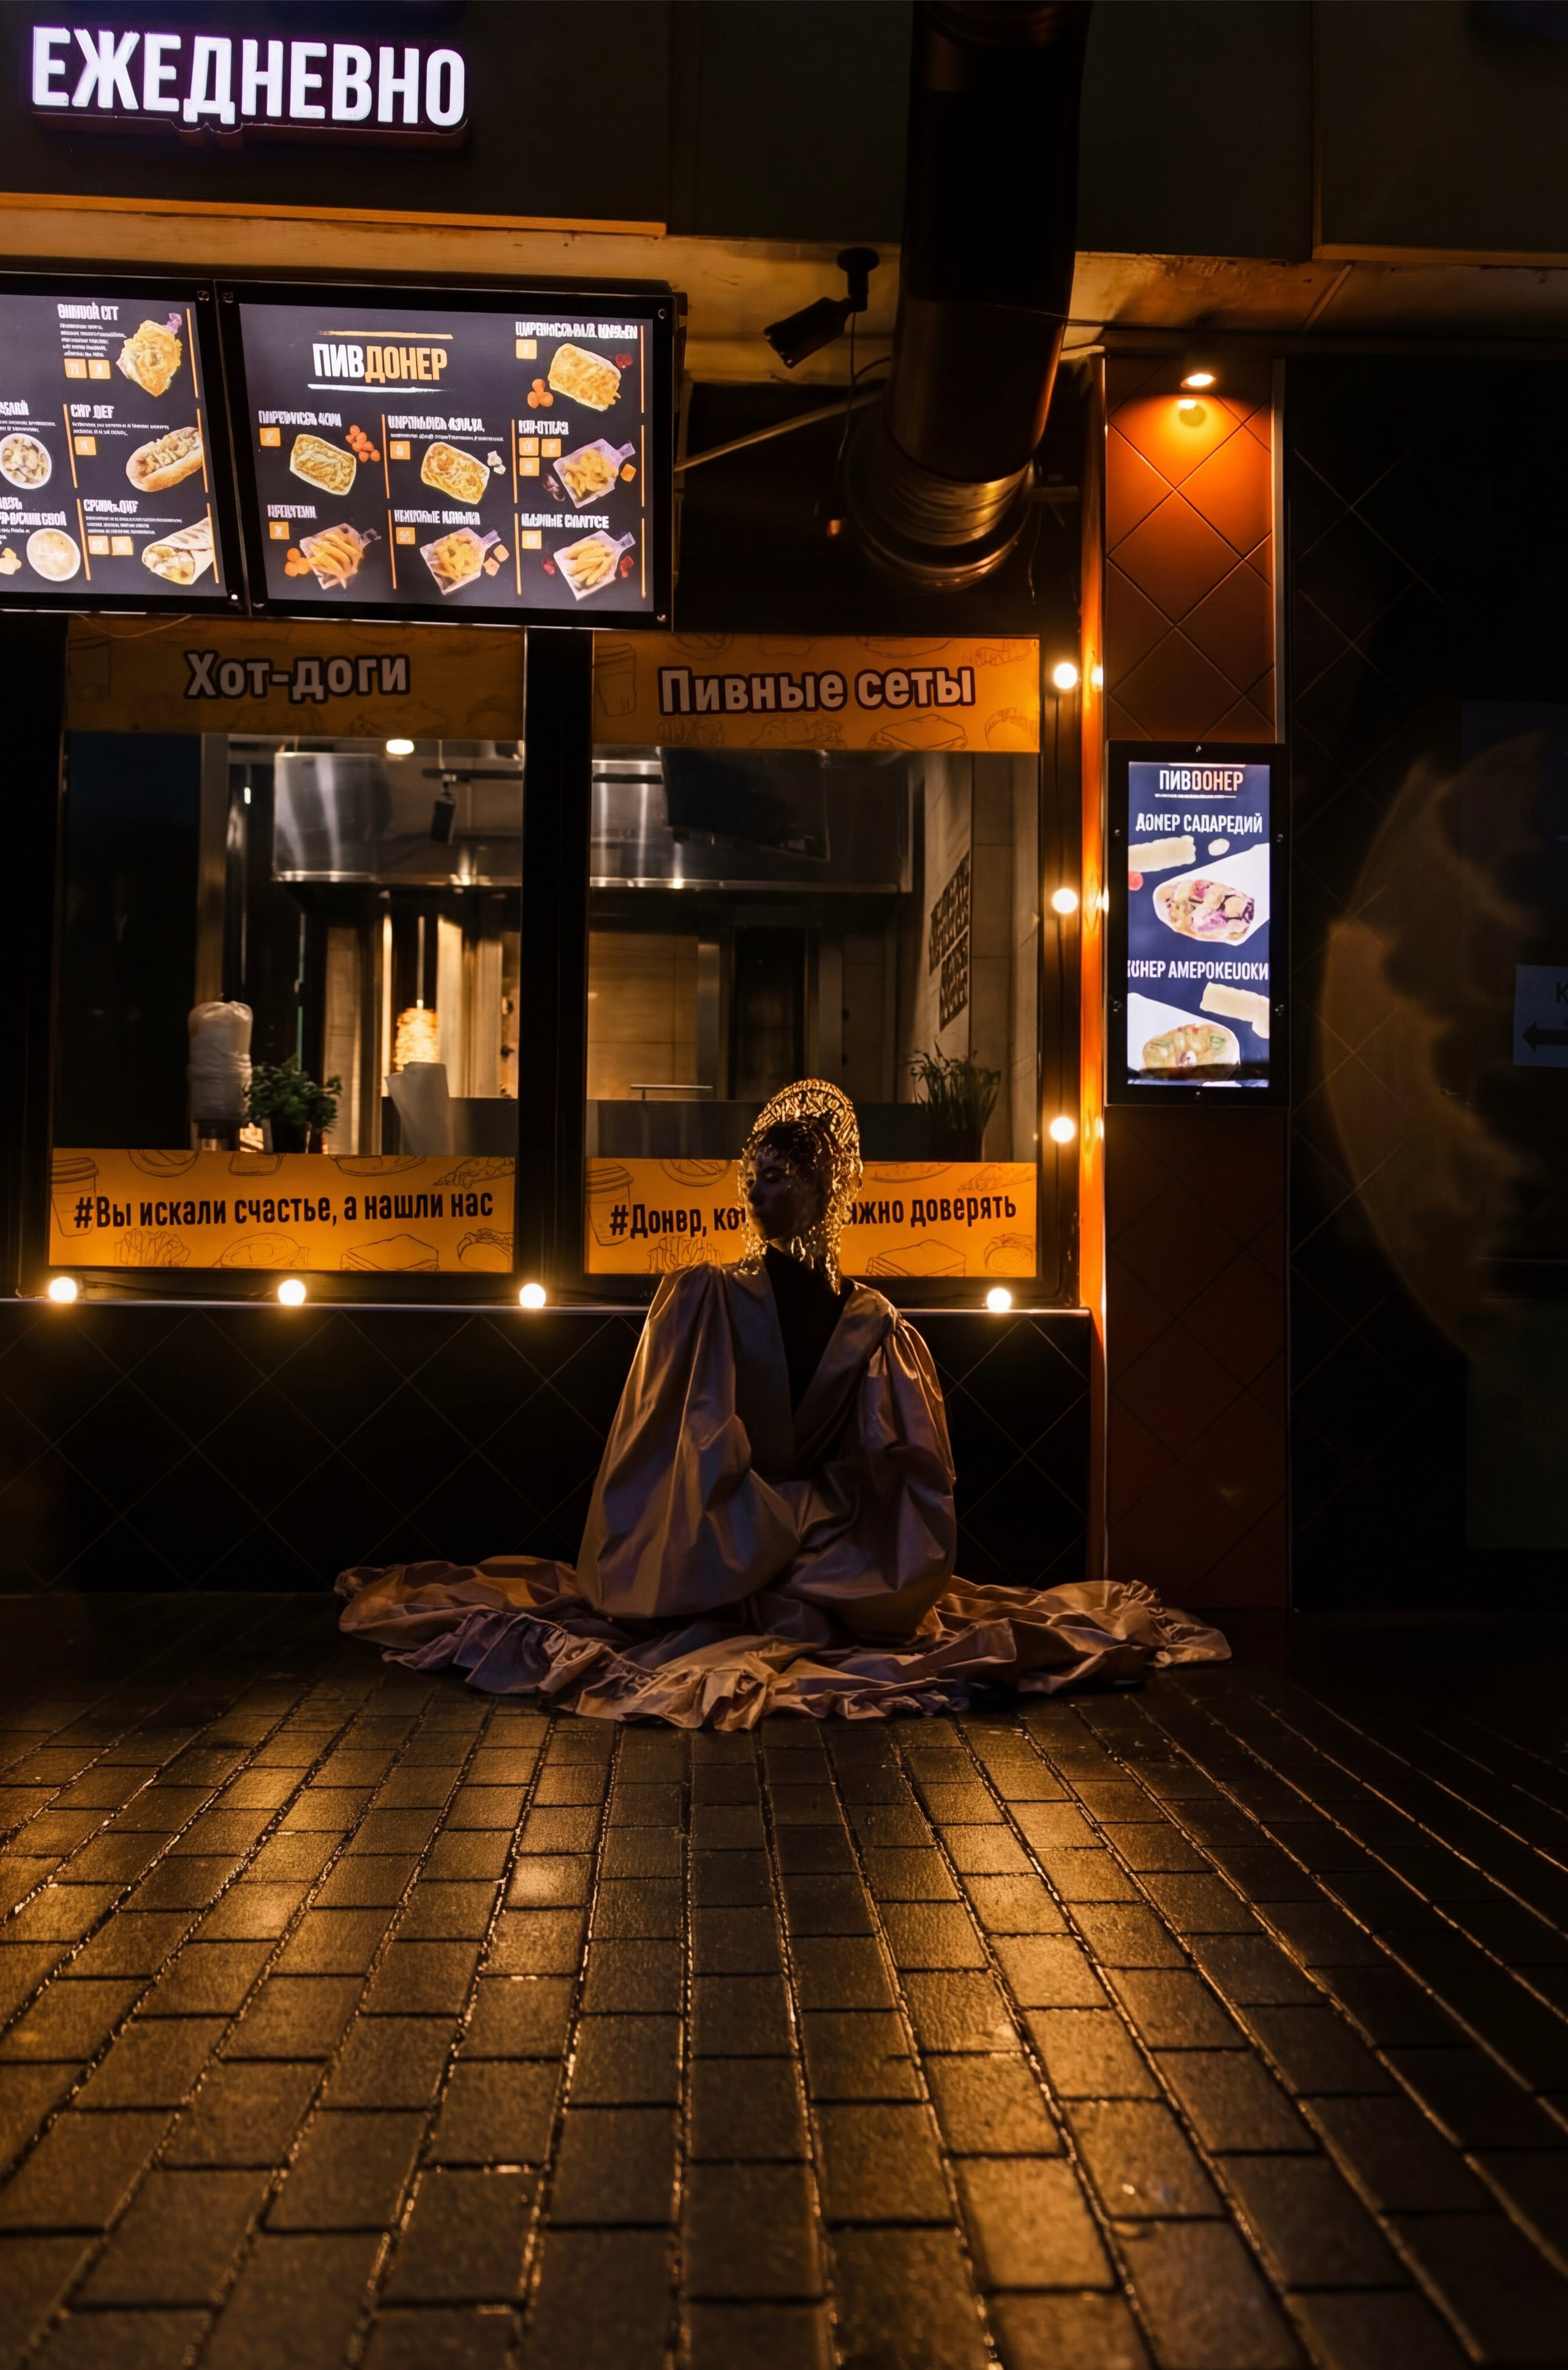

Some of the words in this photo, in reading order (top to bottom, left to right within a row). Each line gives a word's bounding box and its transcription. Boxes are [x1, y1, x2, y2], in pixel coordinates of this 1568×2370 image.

[32, 26, 465, 126] ЕЖЕДНЕВНО
[312, 343, 448, 383] ПИВДОНЕР
[183, 651, 408, 703] Хот-доги
[658, 668, 846, 714] Пивные
[856, 668, 974, 709] сеты
[74, 1196, 130, 1228] #Вы
[140, 1199, 225, 1227] искали
[235, 1196, 338, 1227] счастье,
[344, 1198, 356, 1221] а
[364, 1193, 443, 1221] нашли
[451, 1192, 493, 1217] нас
[910, 1196, 1016, 1228] доверять
